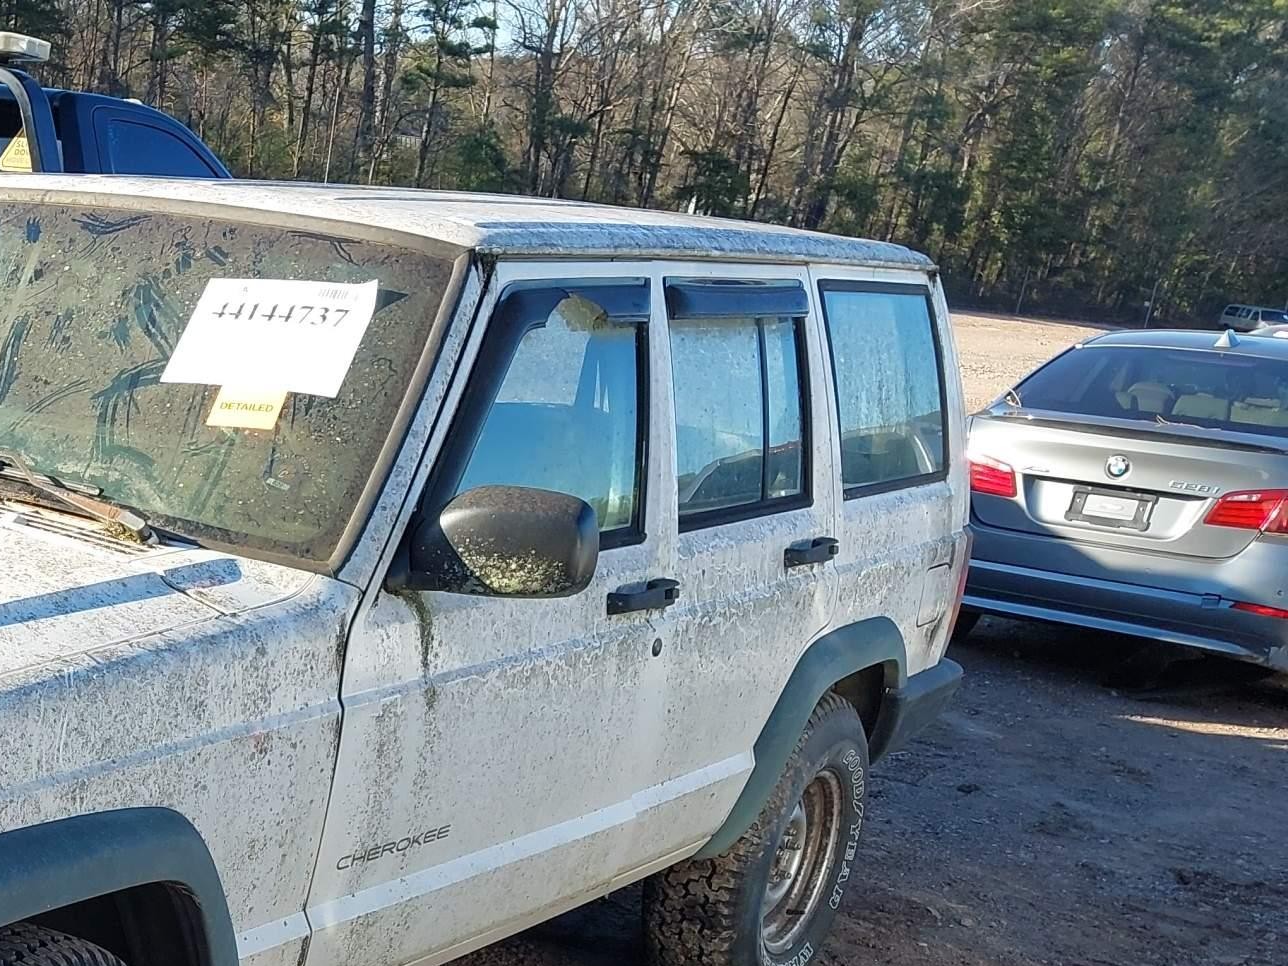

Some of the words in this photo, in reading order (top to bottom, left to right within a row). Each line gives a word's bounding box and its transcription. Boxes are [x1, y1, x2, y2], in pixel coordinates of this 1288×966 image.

[212, 302, 351, 327] 44144737
[219, 401, 274, 412] DETAILED
[336, 824, 452, 870] CHEROKEE
